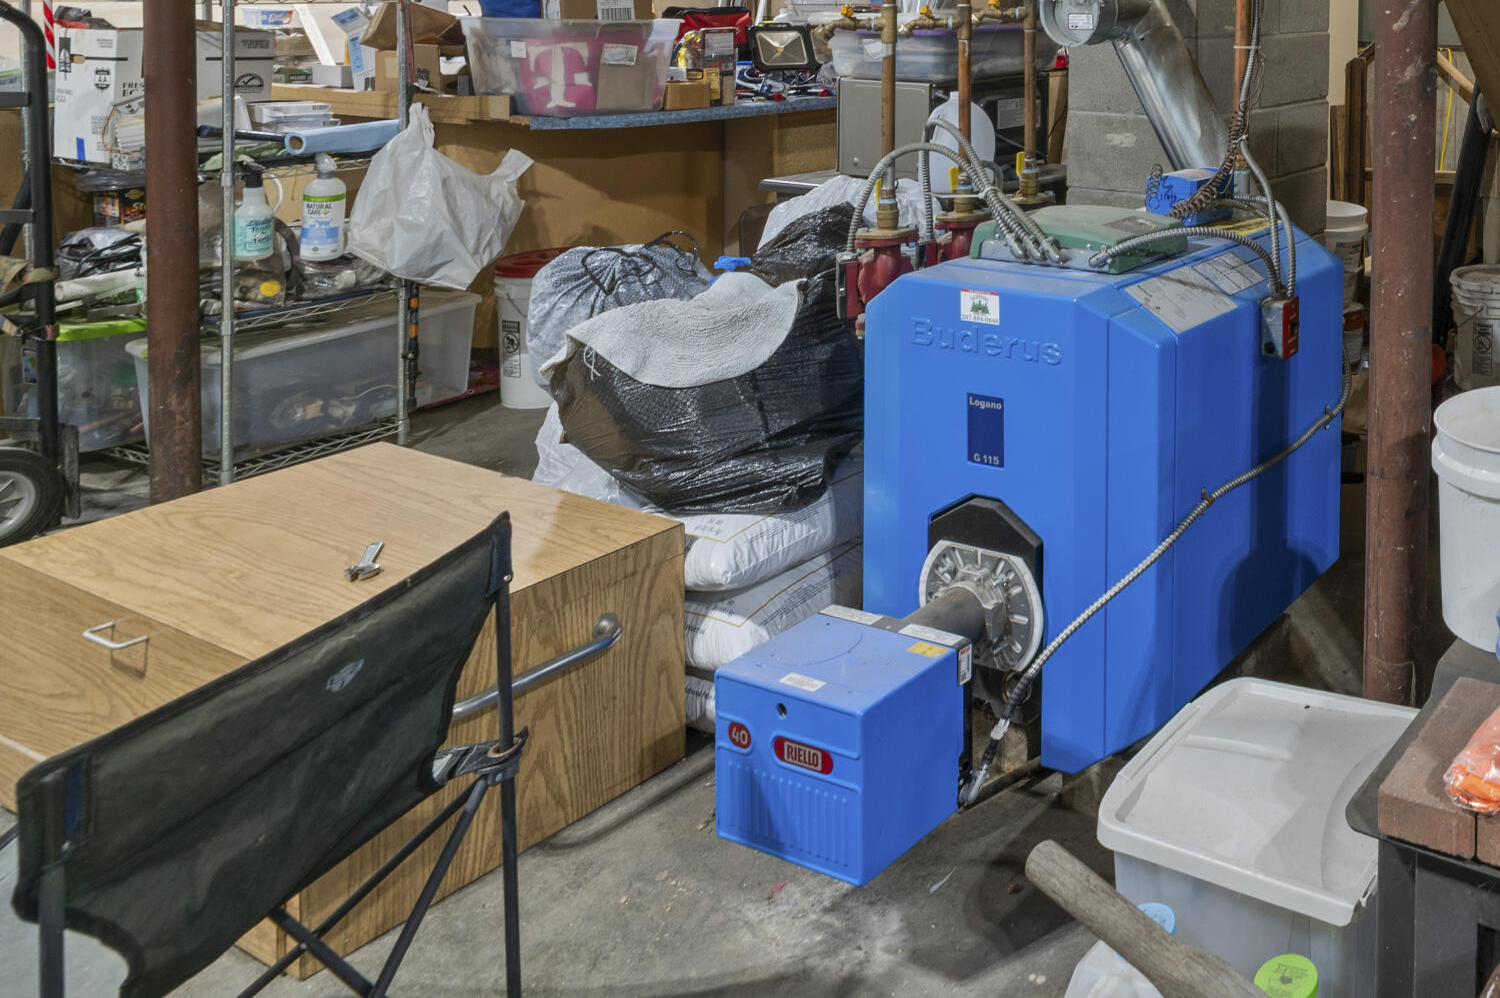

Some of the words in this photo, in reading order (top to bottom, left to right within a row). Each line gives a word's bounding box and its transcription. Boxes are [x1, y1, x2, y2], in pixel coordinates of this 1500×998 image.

[911, 317, 1062, 366] Buderus
[969, 396, 1002, 409] Logano
[973, 453, 981, 462] G
[983, 455, 1000, 465] 115
[731, 726, 748, 745] 40
[787, 744, 819, 768] RIELLO
